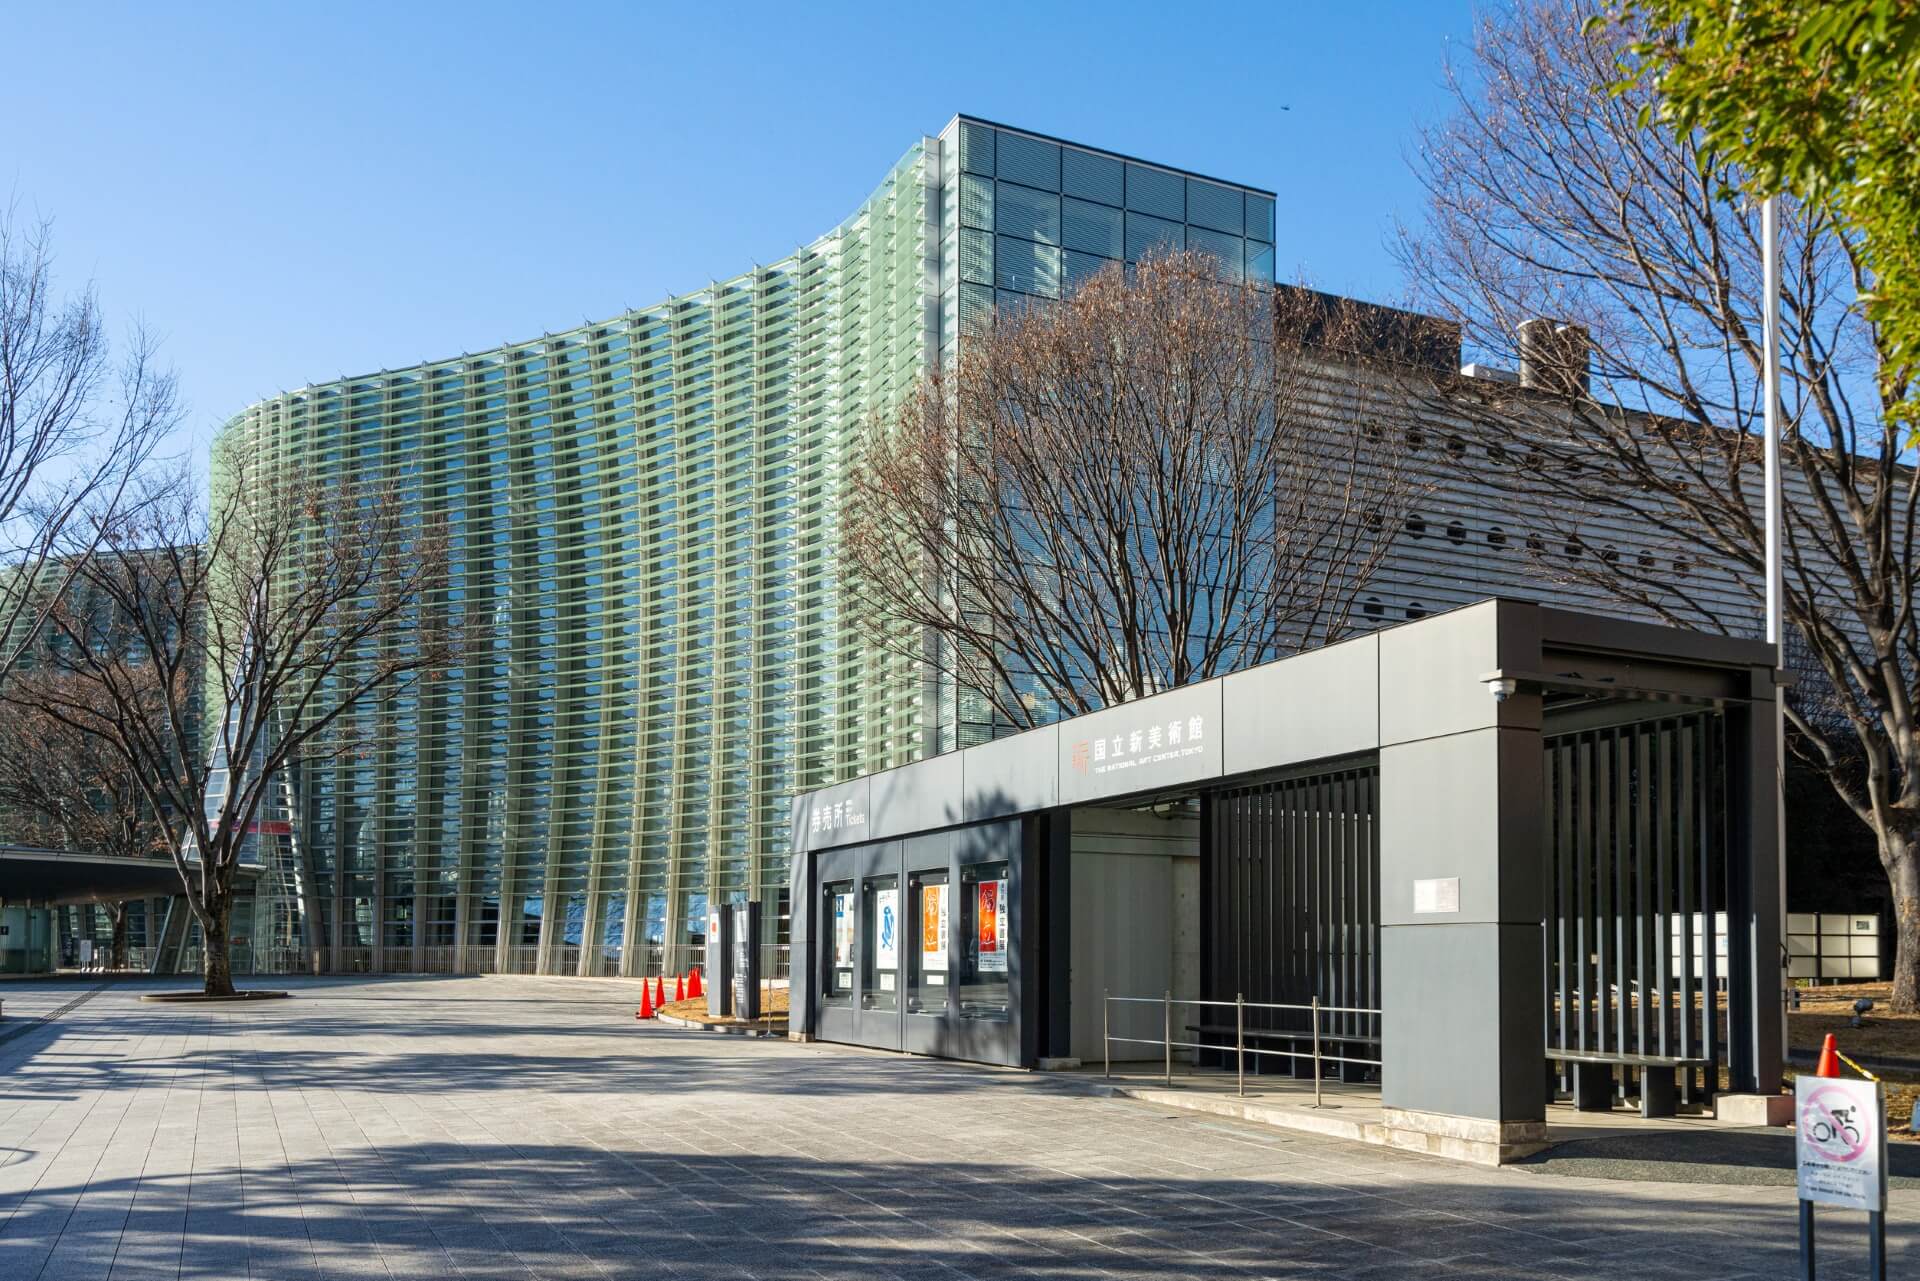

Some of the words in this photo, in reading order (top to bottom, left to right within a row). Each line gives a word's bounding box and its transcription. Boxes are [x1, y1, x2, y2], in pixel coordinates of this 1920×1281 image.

[1094, 714, 1203, 761] 国立新美術館
[1095, 766, 1106, 774] THE
[1107, 760, 1137, 771] NATIONAL
[1139, 755, 1152, 764] ART
[1181, 745, 1203, 757] TOKYO
